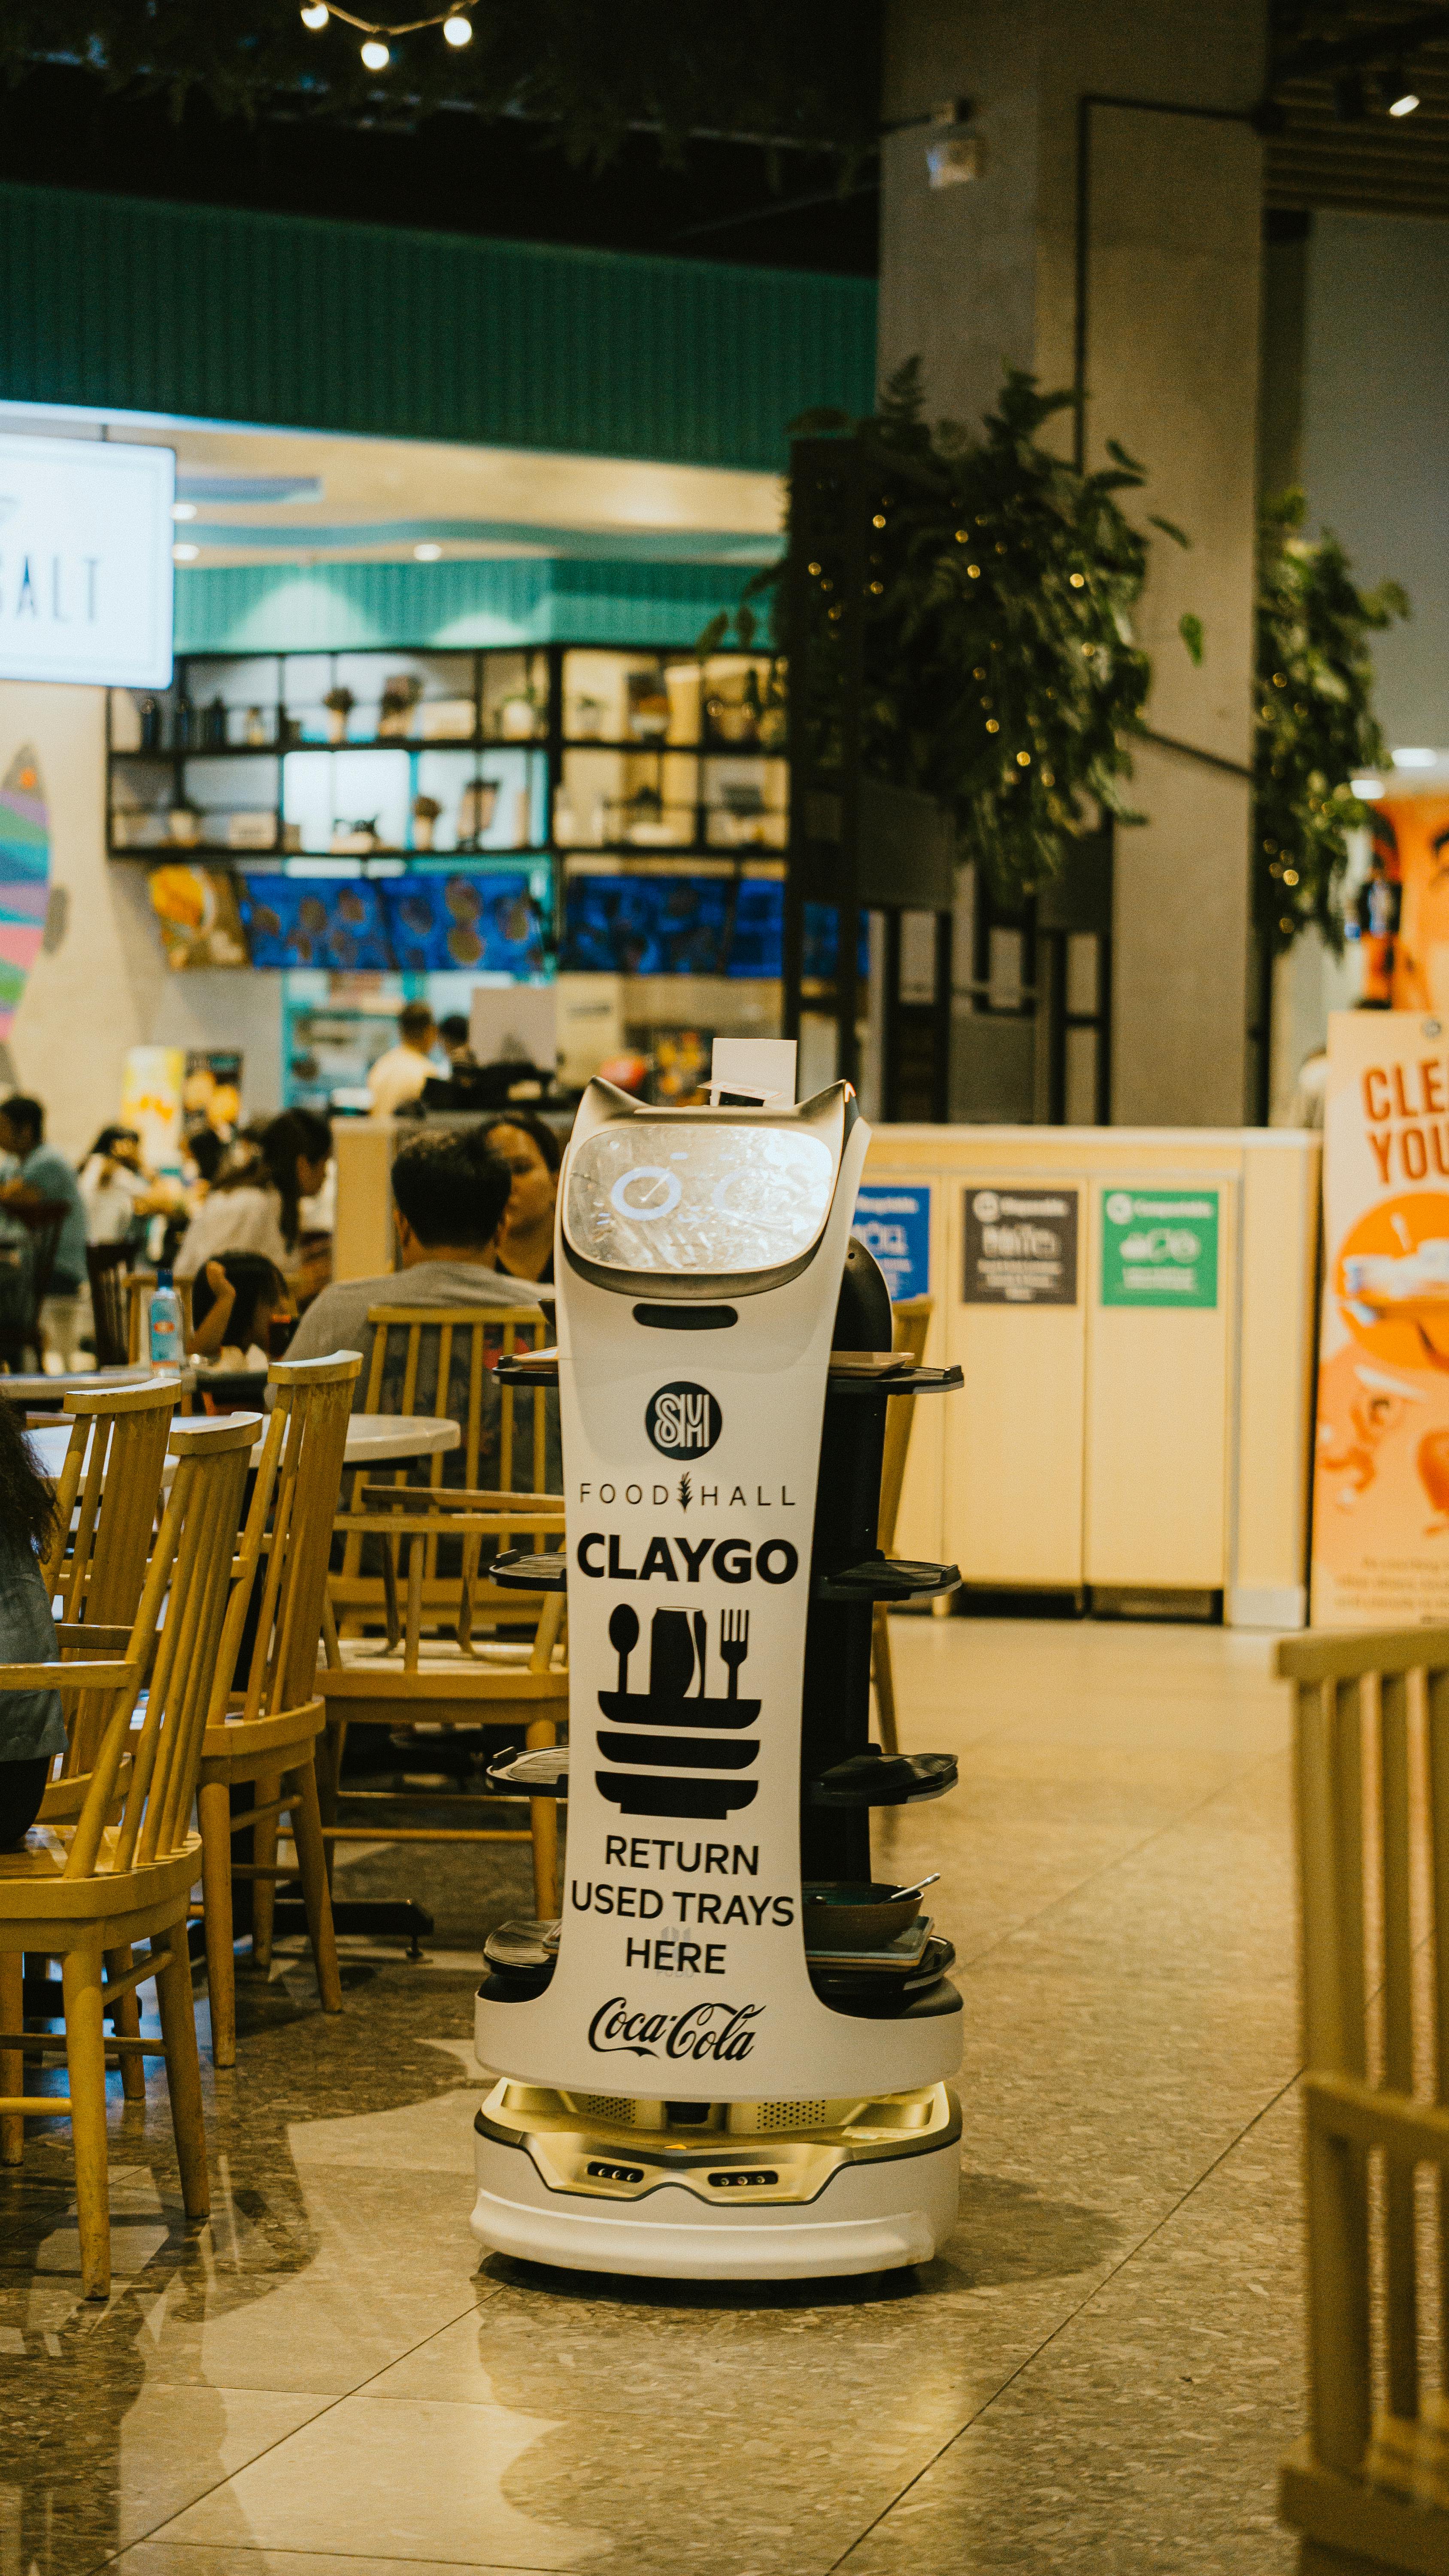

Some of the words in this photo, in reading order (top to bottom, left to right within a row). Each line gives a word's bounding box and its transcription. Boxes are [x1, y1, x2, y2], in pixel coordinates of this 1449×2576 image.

[0, 550, 99, 622] ALT
[1363, 1059, 1449, 1121] CLE
[579, 1482, 670, 1506] FOOD
[701, 1485, 796, 1507] HALL
[576, 1532, 799, 1585] CLAYGO
[605, 1834, 759, 1876] RETURN
[571, 1879, 664, 1920] USED
[672, 1891, 794, 1927] TRAYS
[626, 1936, 727, 1975] HERE
[588, 1996, 766, 2061] Coca-Cola
